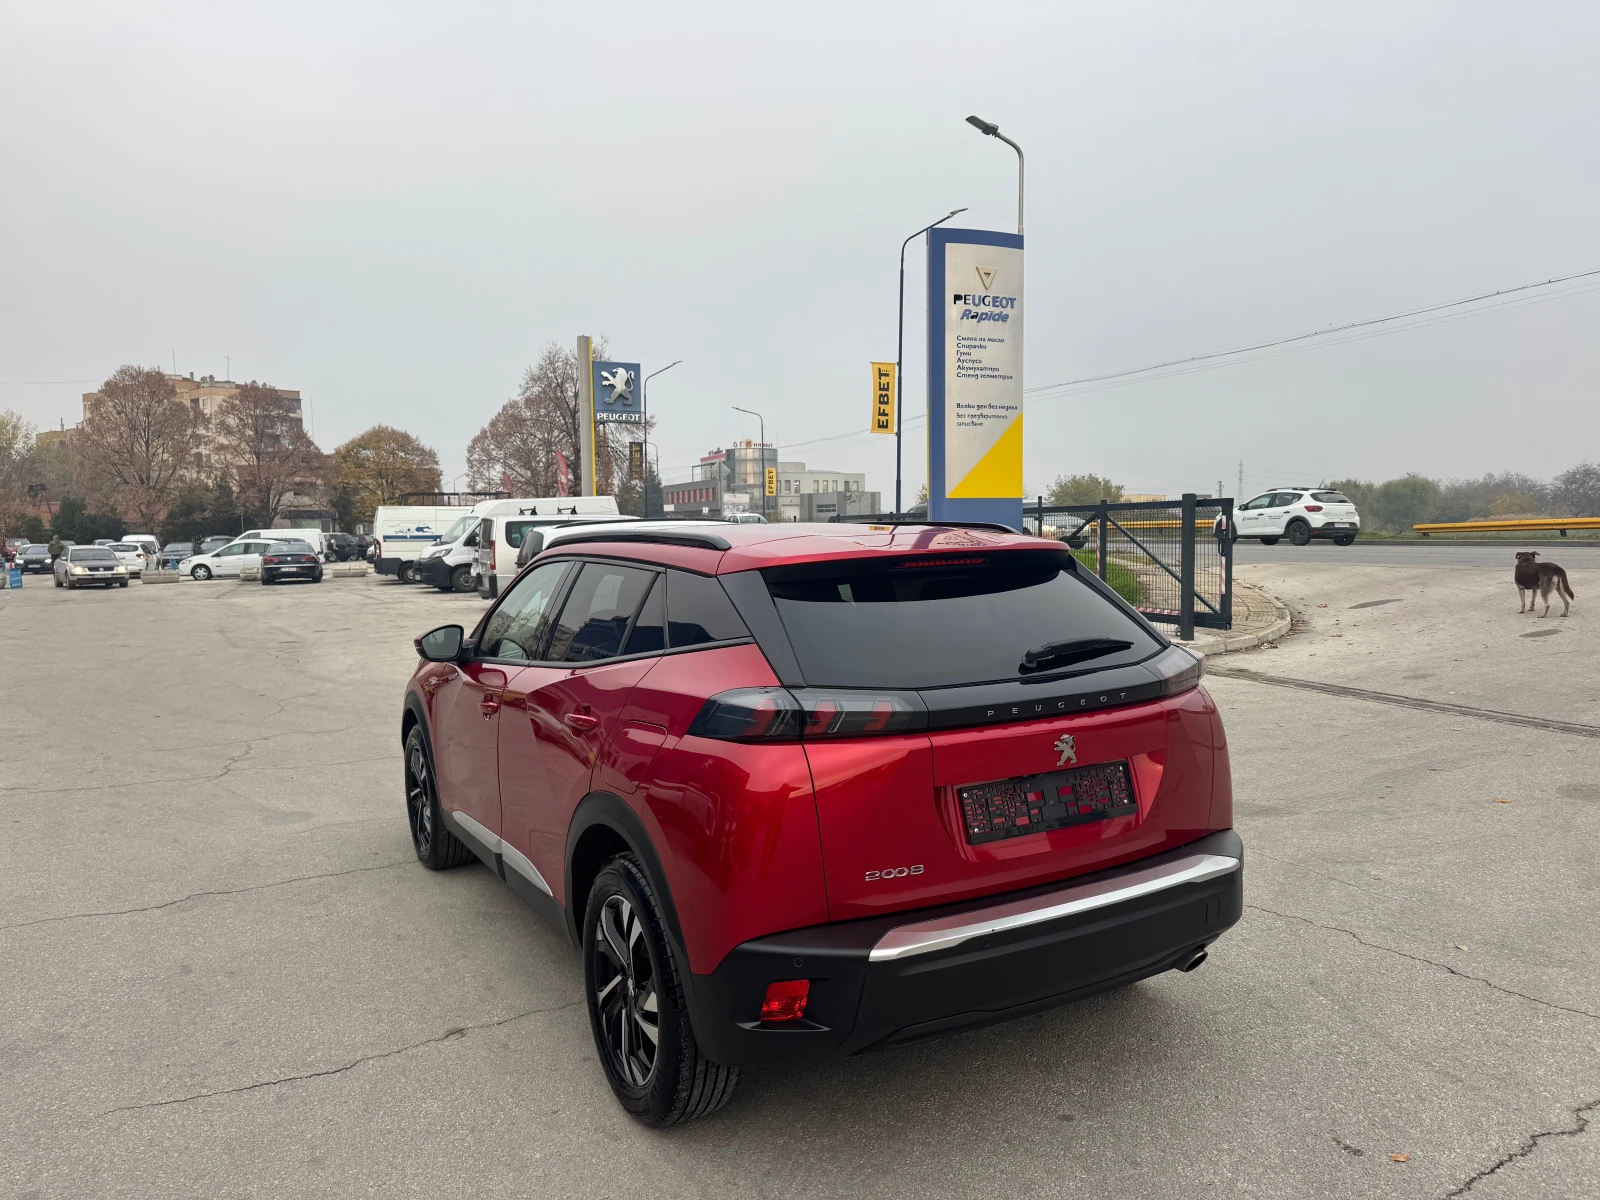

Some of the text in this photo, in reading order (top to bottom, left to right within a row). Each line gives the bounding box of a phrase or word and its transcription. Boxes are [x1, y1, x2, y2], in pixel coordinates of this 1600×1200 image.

[953, 294, 1016, 309] PEUGEOT
[960, 308, 1010, 323] Rapide
[956, 342, 987, 350] Спирачки
[956, 357, 983, 365] Ауспуси
[956, 364, 1000, 373] Акумулатори
[956, 372, 979, 380] Стенд
[877, 366, 890, 429] EFBET
[596, 412, 641, 422] PEUGEOT
[986, 692, 1128, 717] PEUGEOT
[864, 863, 925, 882] 2008
